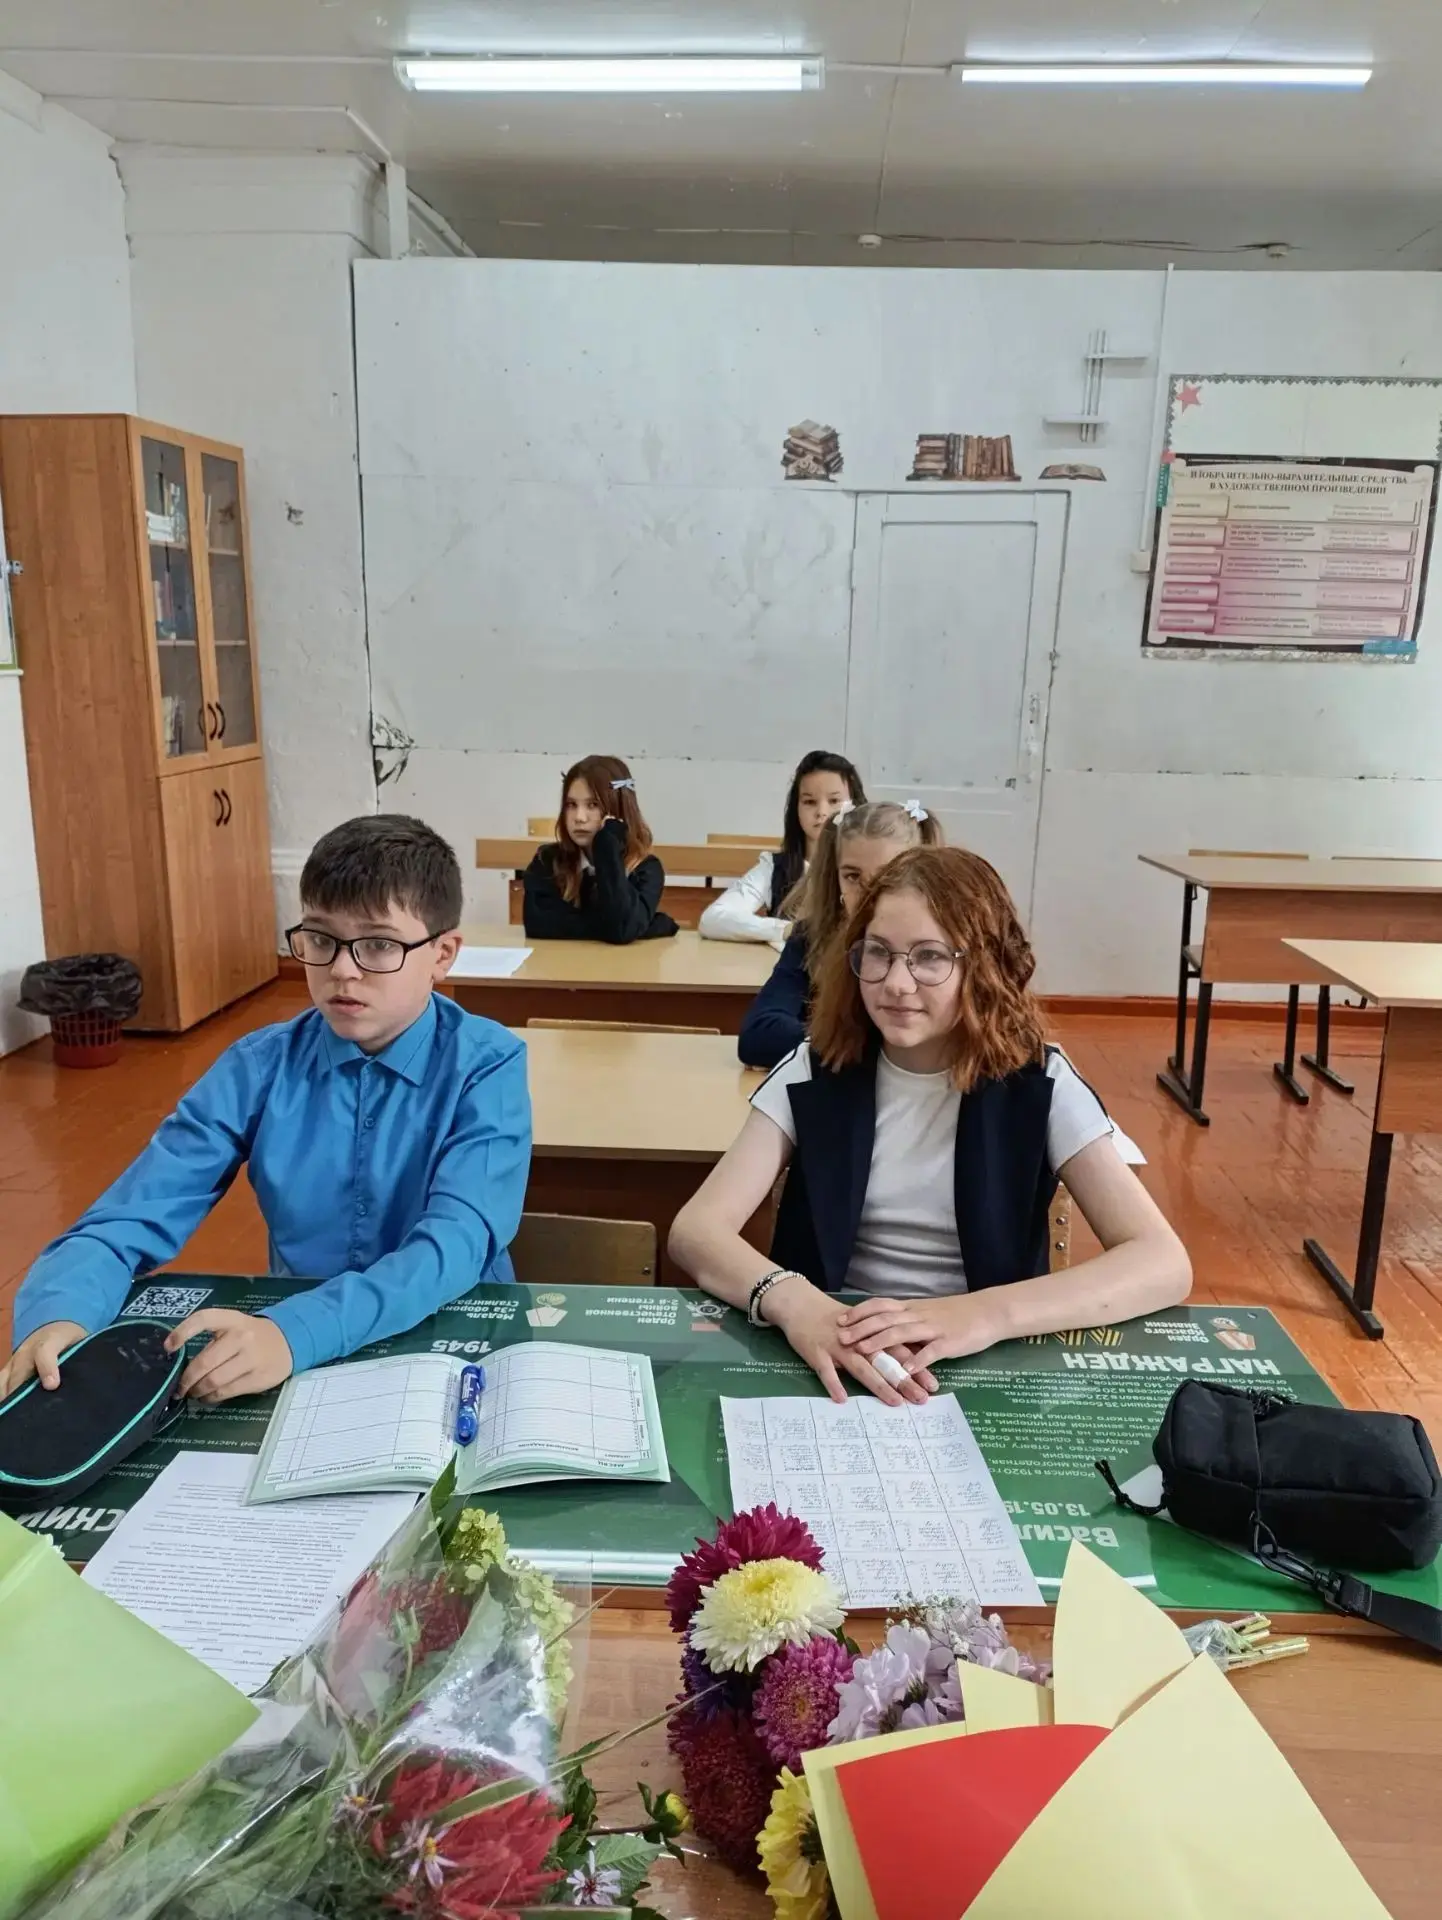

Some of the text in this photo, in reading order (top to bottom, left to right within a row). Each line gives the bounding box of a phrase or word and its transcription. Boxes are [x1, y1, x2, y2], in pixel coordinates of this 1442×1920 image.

[606, 1296, 655, 1305] степени
[638, 1304, 679, 1313] войны
[465, 1311, 515, 1321] Медаль
[585, 1308, 677, 1319] Отечественной
[636, 1316, 676, 1326] Орден
[1144, 1320, 1201, 1330] Знамени
[1144, 1327, 1204, 1337] Красного
[1167, 1334, 1210, 1344] Орден
[430, 1339, 493, 1354] 1945
[742, 1360, 808, 1369] стребителя.
[1061, 1351, 1281, 1376] НАГРАЖДЕН
[1071, 1422, 1124, 1430] зенитной
[1000, 1427, 1073, 1435] выполнение
[1011, 1442, 1051, 1451] отвагу
[1068, 1445, 1129, 1454] Мужество
[988, 1458, 1070, 1468] многодетная,
[1003, 1468, 1032, 1476] 1920
[1044, 1469, 1096, 1478] Родился
